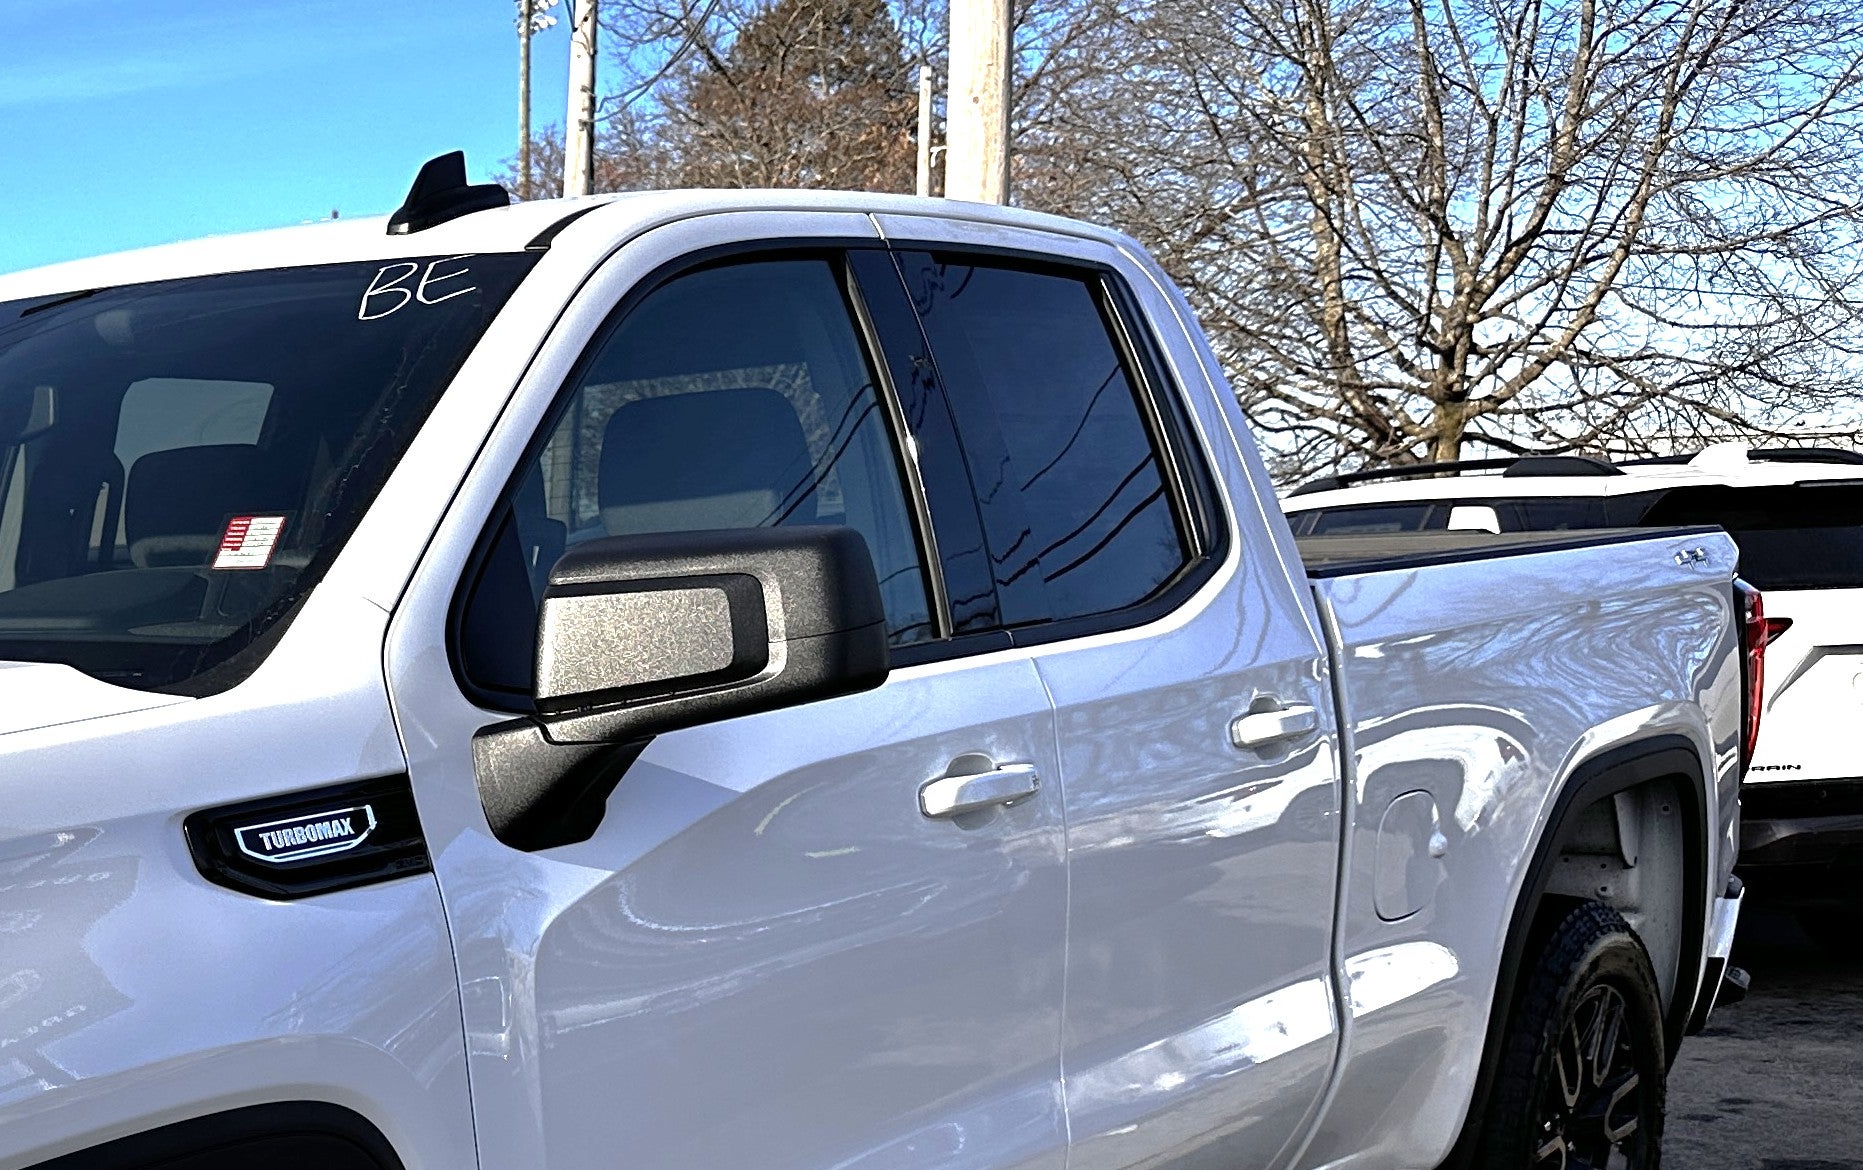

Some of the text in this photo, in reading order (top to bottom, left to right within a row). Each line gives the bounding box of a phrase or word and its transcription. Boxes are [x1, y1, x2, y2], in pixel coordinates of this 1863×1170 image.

[358, 254, 477, 320] BE
[1749, 764, 1802, 772] RAIN
[259, 818, 356, 851] TURBOMAX
